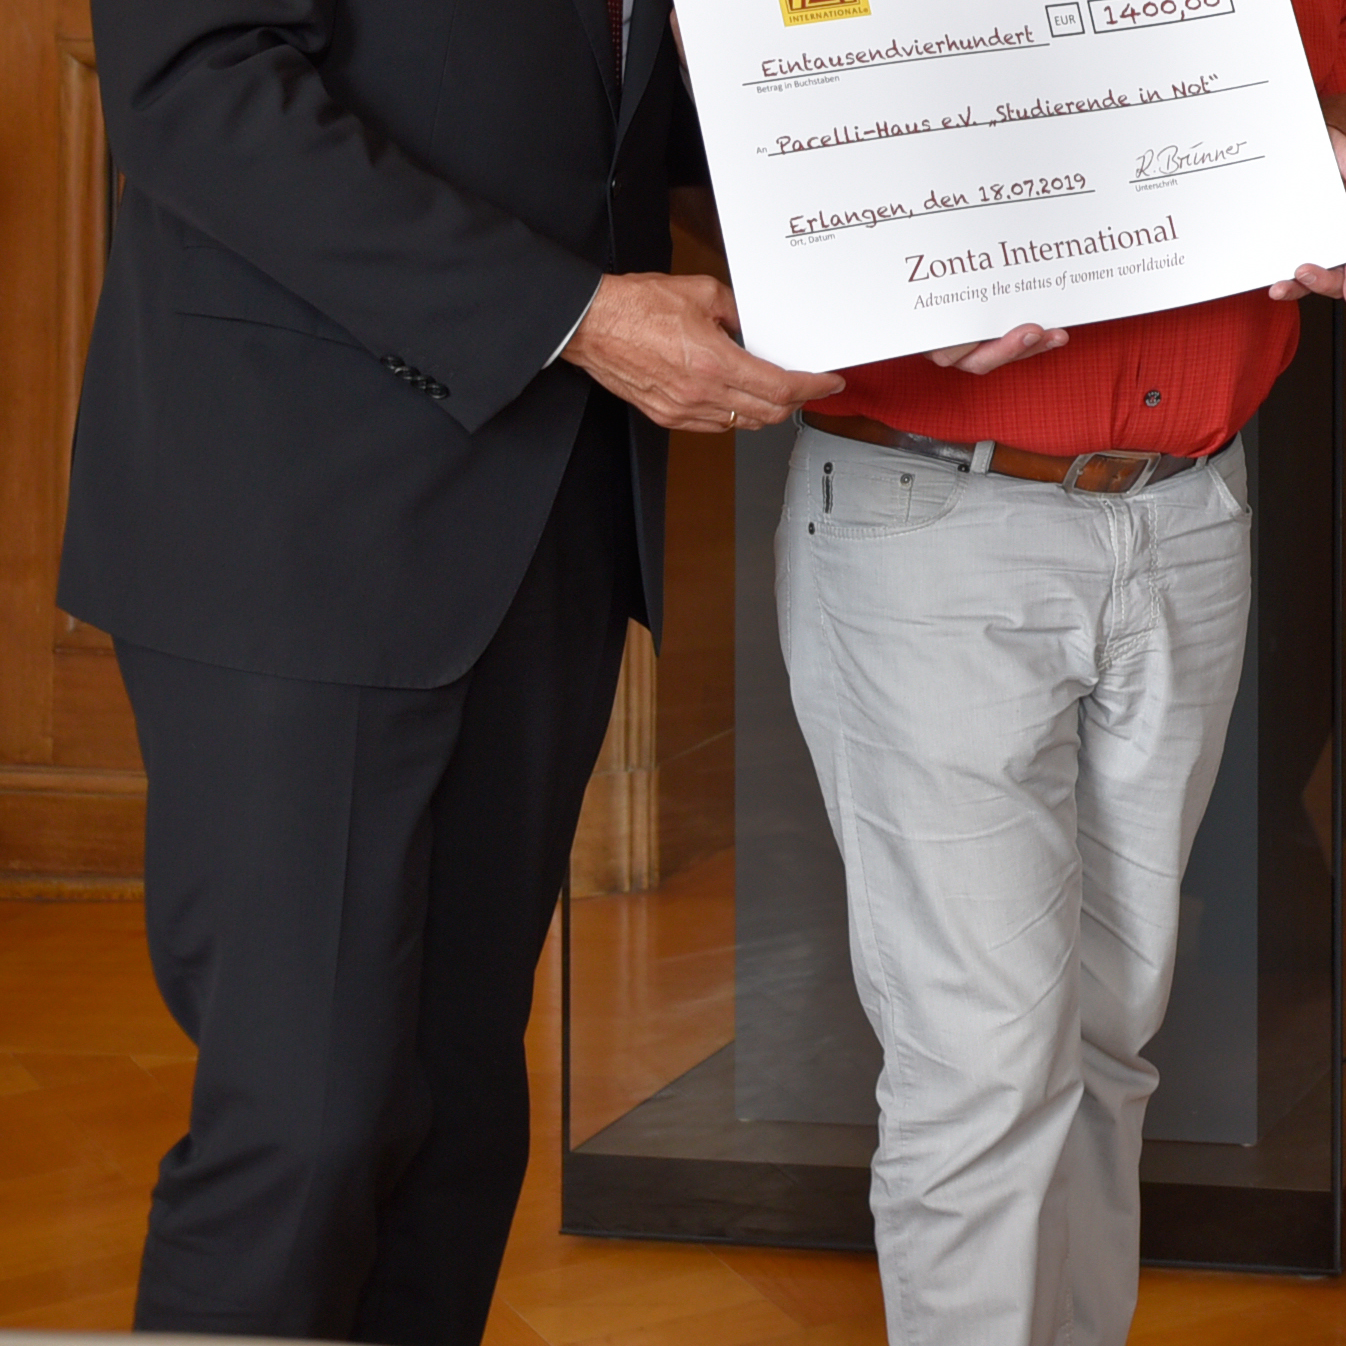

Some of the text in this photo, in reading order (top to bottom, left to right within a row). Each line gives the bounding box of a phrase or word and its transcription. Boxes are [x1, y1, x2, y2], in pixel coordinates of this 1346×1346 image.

[1054, 14, 1076, 26] EUR
[761, 24, 1034, 78] Eintausendvierhundert
[756, 75, 840, 94] Betrag in Buchstaben
[777, 118, 931, 154] Pacelli-Haus
[941, 105, 976, 130] e.V.
[1139, 88, 1162, 104] in
[756, 145, 768, 155] An
[1135, 178, 1178, 192] Unterschrift
[789, 173, 1086, 234] Erlangen, den 18.07.2019
[790, 233, 836, 248] Ort, Datum
[905, 215, 1179, 284] Zonta International
[914, 252, 1185, 310] Advancing the status of women worldwide
